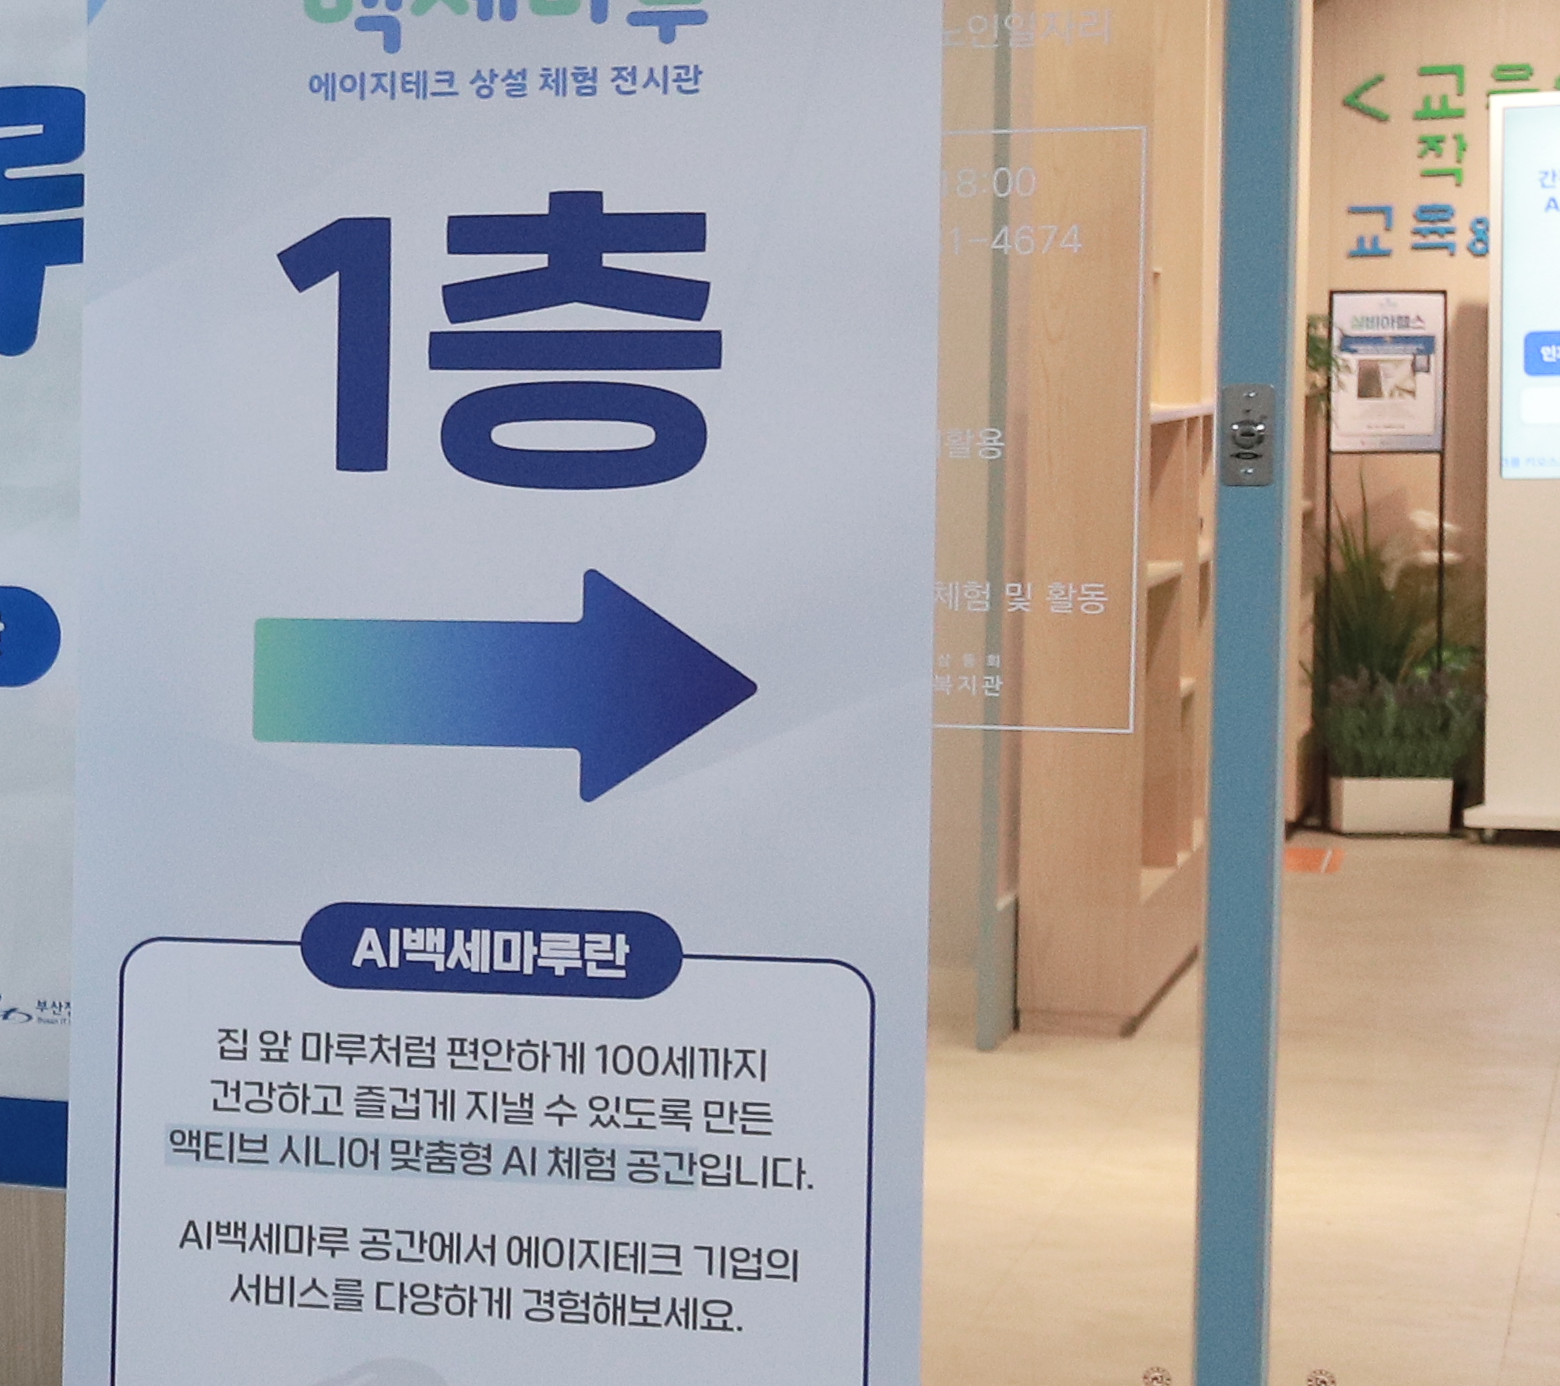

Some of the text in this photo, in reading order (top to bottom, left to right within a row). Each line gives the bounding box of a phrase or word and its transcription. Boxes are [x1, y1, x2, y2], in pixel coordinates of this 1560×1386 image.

[308, 63, 703, 102] 에이지테크 상설 체험 전시관
[276, 190, 723, 491] 1층
[1004, 582, 1032, 612] 및
[1046, 582, 1108, 614] 활동
[351, 925, 630, 981] AI백세마루란
[217, 1029, 769, 1083] 집 앞 마루처럼 편안하게 100세까지
[169, 1127, 816, 1191] 액티브 시니어 맞춤형 AI 체험 공간입니다.
[178, 1219, 800, 1284] AI백세마루 공간에서 에이지테크 기업의
[229, 1271, 744, 1334] 서비스를 다양하게 경험해보세요.
